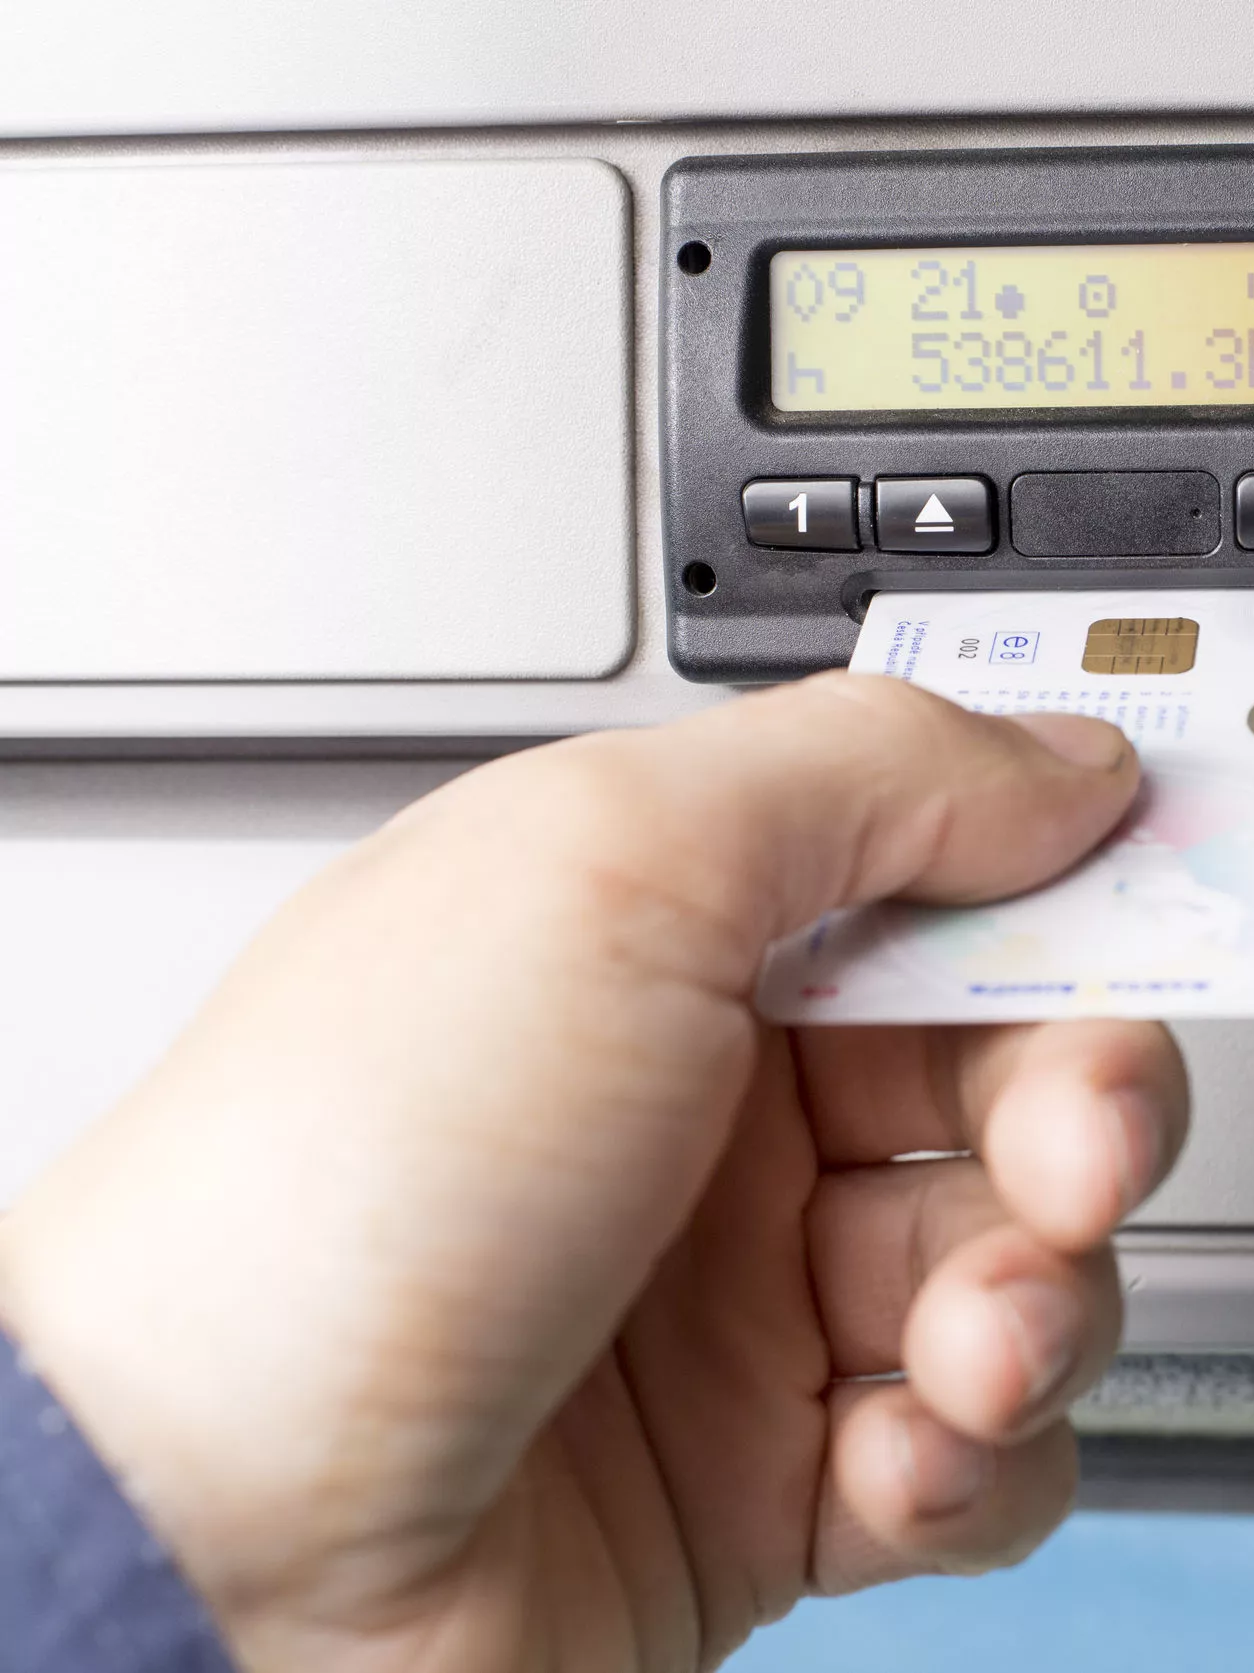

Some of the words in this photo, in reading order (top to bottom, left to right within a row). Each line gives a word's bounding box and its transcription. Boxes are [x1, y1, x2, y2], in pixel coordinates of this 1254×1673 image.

[787, 262, 864, 321] 09
[911, 260, 983, 320] 21
[788, 492, 808, 533] 1
[958, 638, 980, 659] 002
